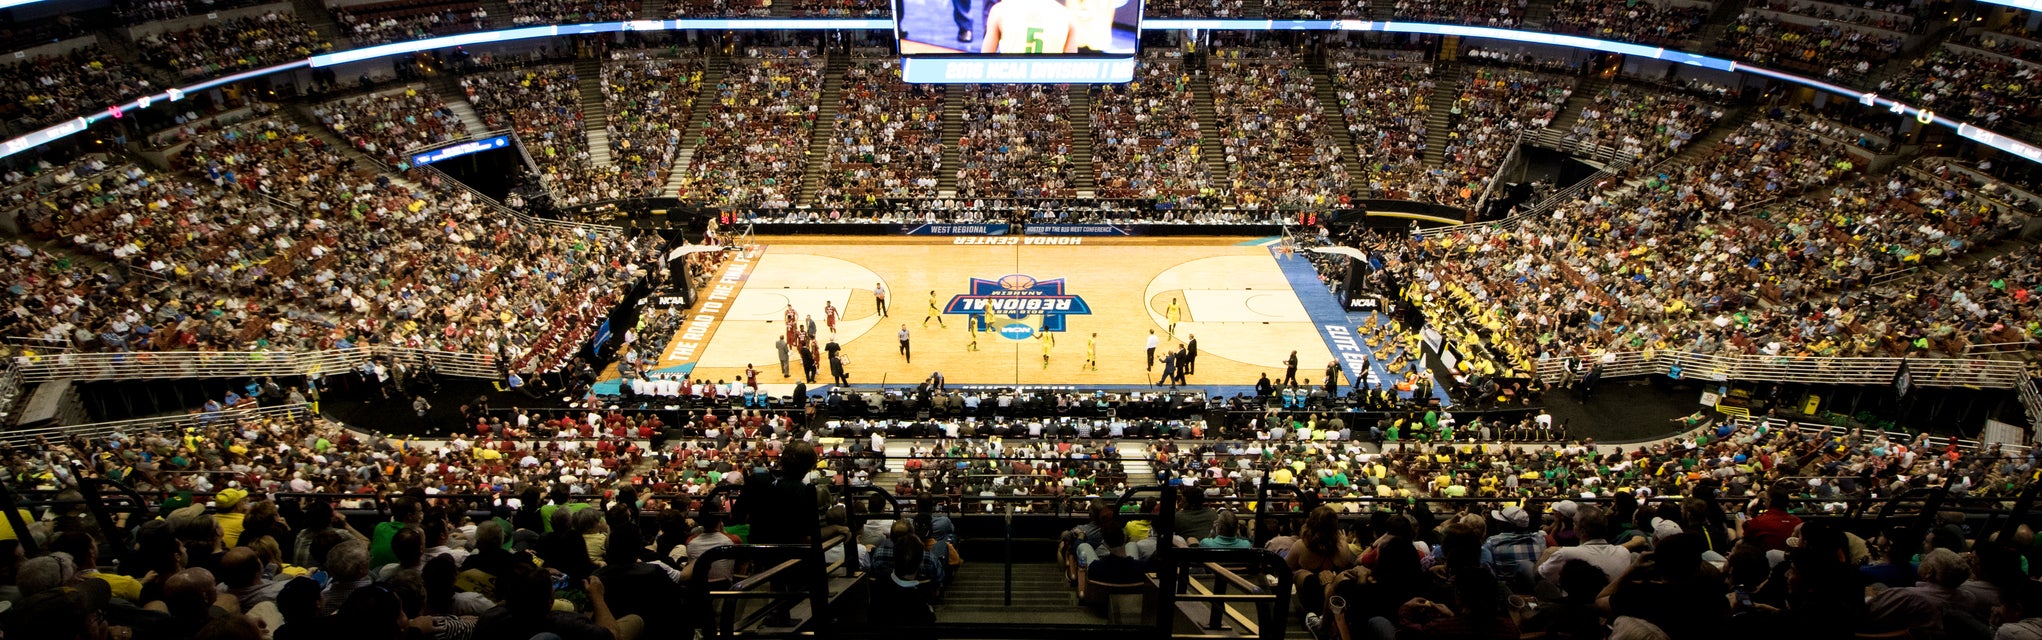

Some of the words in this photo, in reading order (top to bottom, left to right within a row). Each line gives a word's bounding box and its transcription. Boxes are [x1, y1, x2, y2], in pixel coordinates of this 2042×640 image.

[945, 62, 985, 79] 2016
[986, 62, 1028, 79] NCAA
[1030, 62, 1100, 79] DIVISION
[931, 226, 951, 234] WEST
[952, 226, 987, 234] REGIONAL
[953, 237, 1019, 245] CENTER
[1024, 237, 1082, 245] HONDA
[720, 263, 748, 285] FINAL
[708, 284, 734, 300] THE
[660, 297, 684, 305] NCAA
[700, 301, 723, 313] TO
[1351, 299, 1376, 307] NCAA
[682, 315, 715, 341] ROAD
[1324, 324, 1361, 352] ELITE
[668, 341, 698, 361] THE
